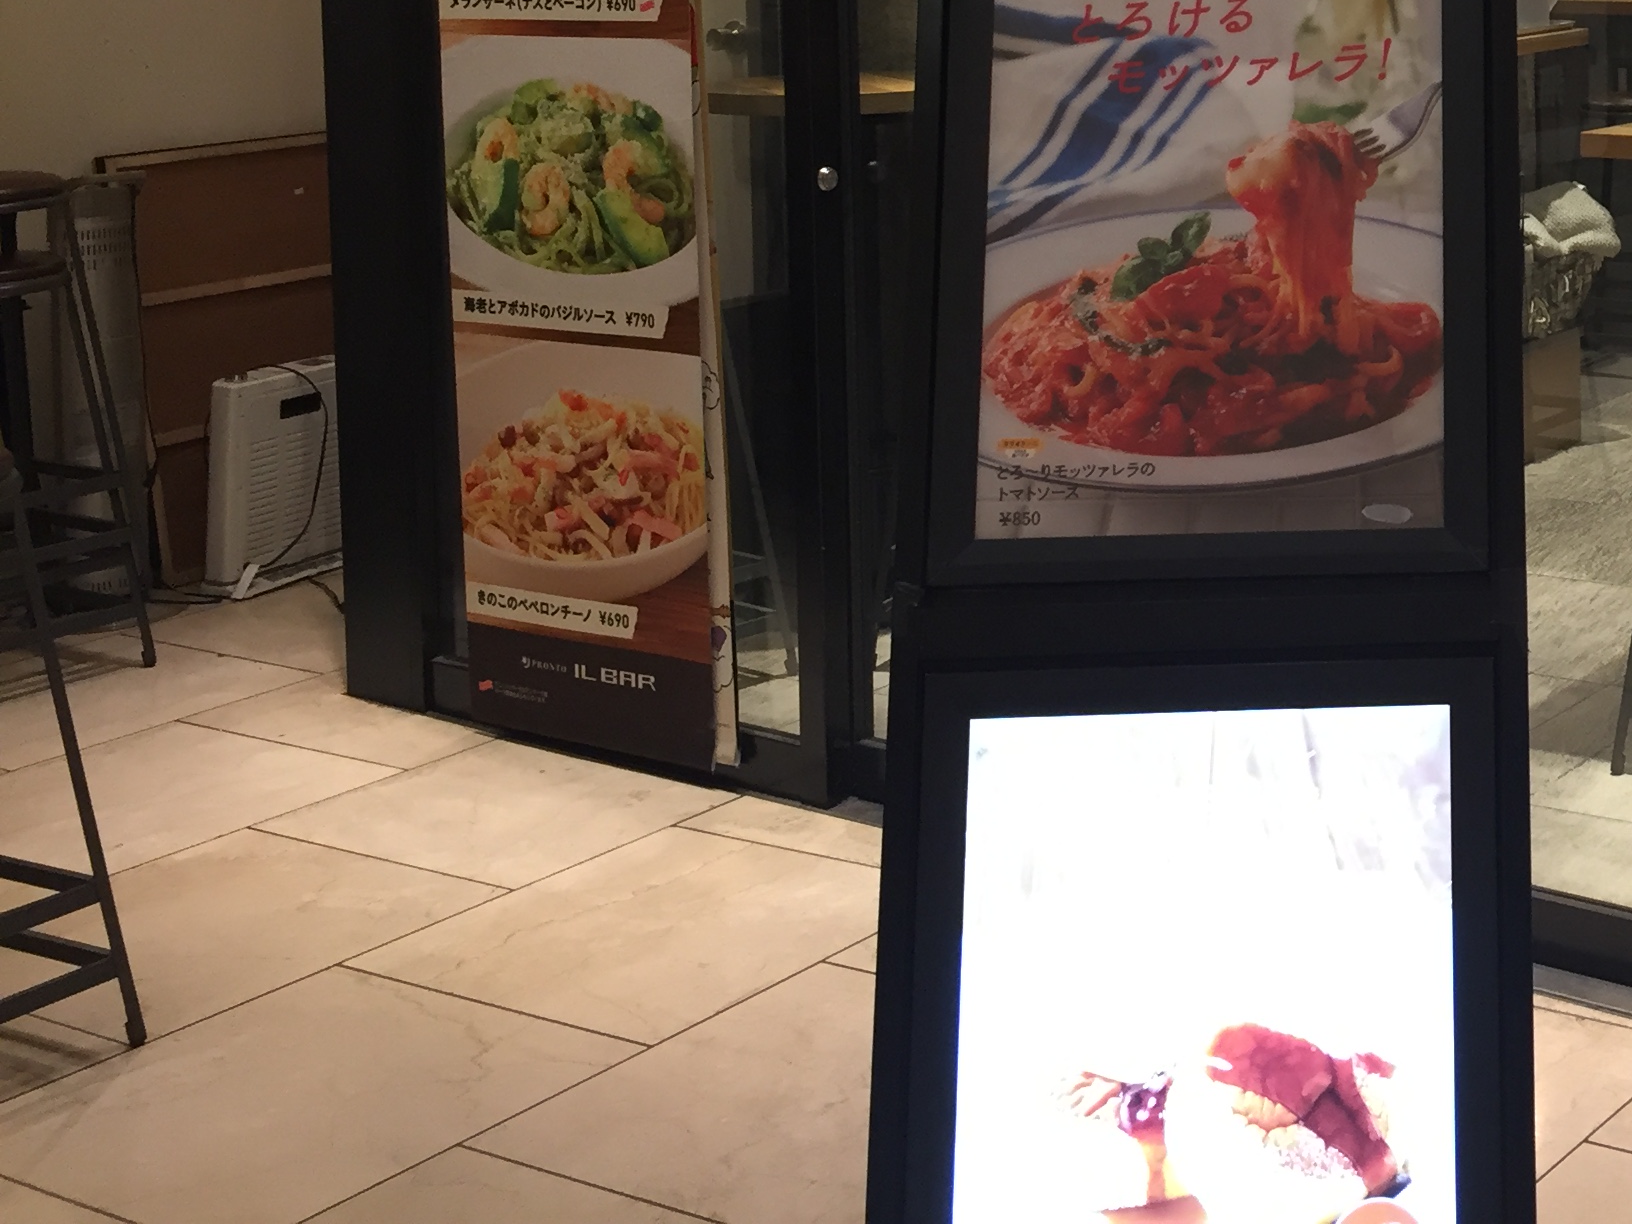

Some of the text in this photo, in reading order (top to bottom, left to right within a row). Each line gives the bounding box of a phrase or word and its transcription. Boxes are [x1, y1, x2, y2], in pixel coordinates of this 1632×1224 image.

[625, 312, 655, 329] ¥790
[999, 484, 1079, 502] トマトソース
[999, 511, 1041, 527] ¥850
[598, 610, 630, 630] ¥690
[531, 660, 656, 692] PRONTO IL BAR
